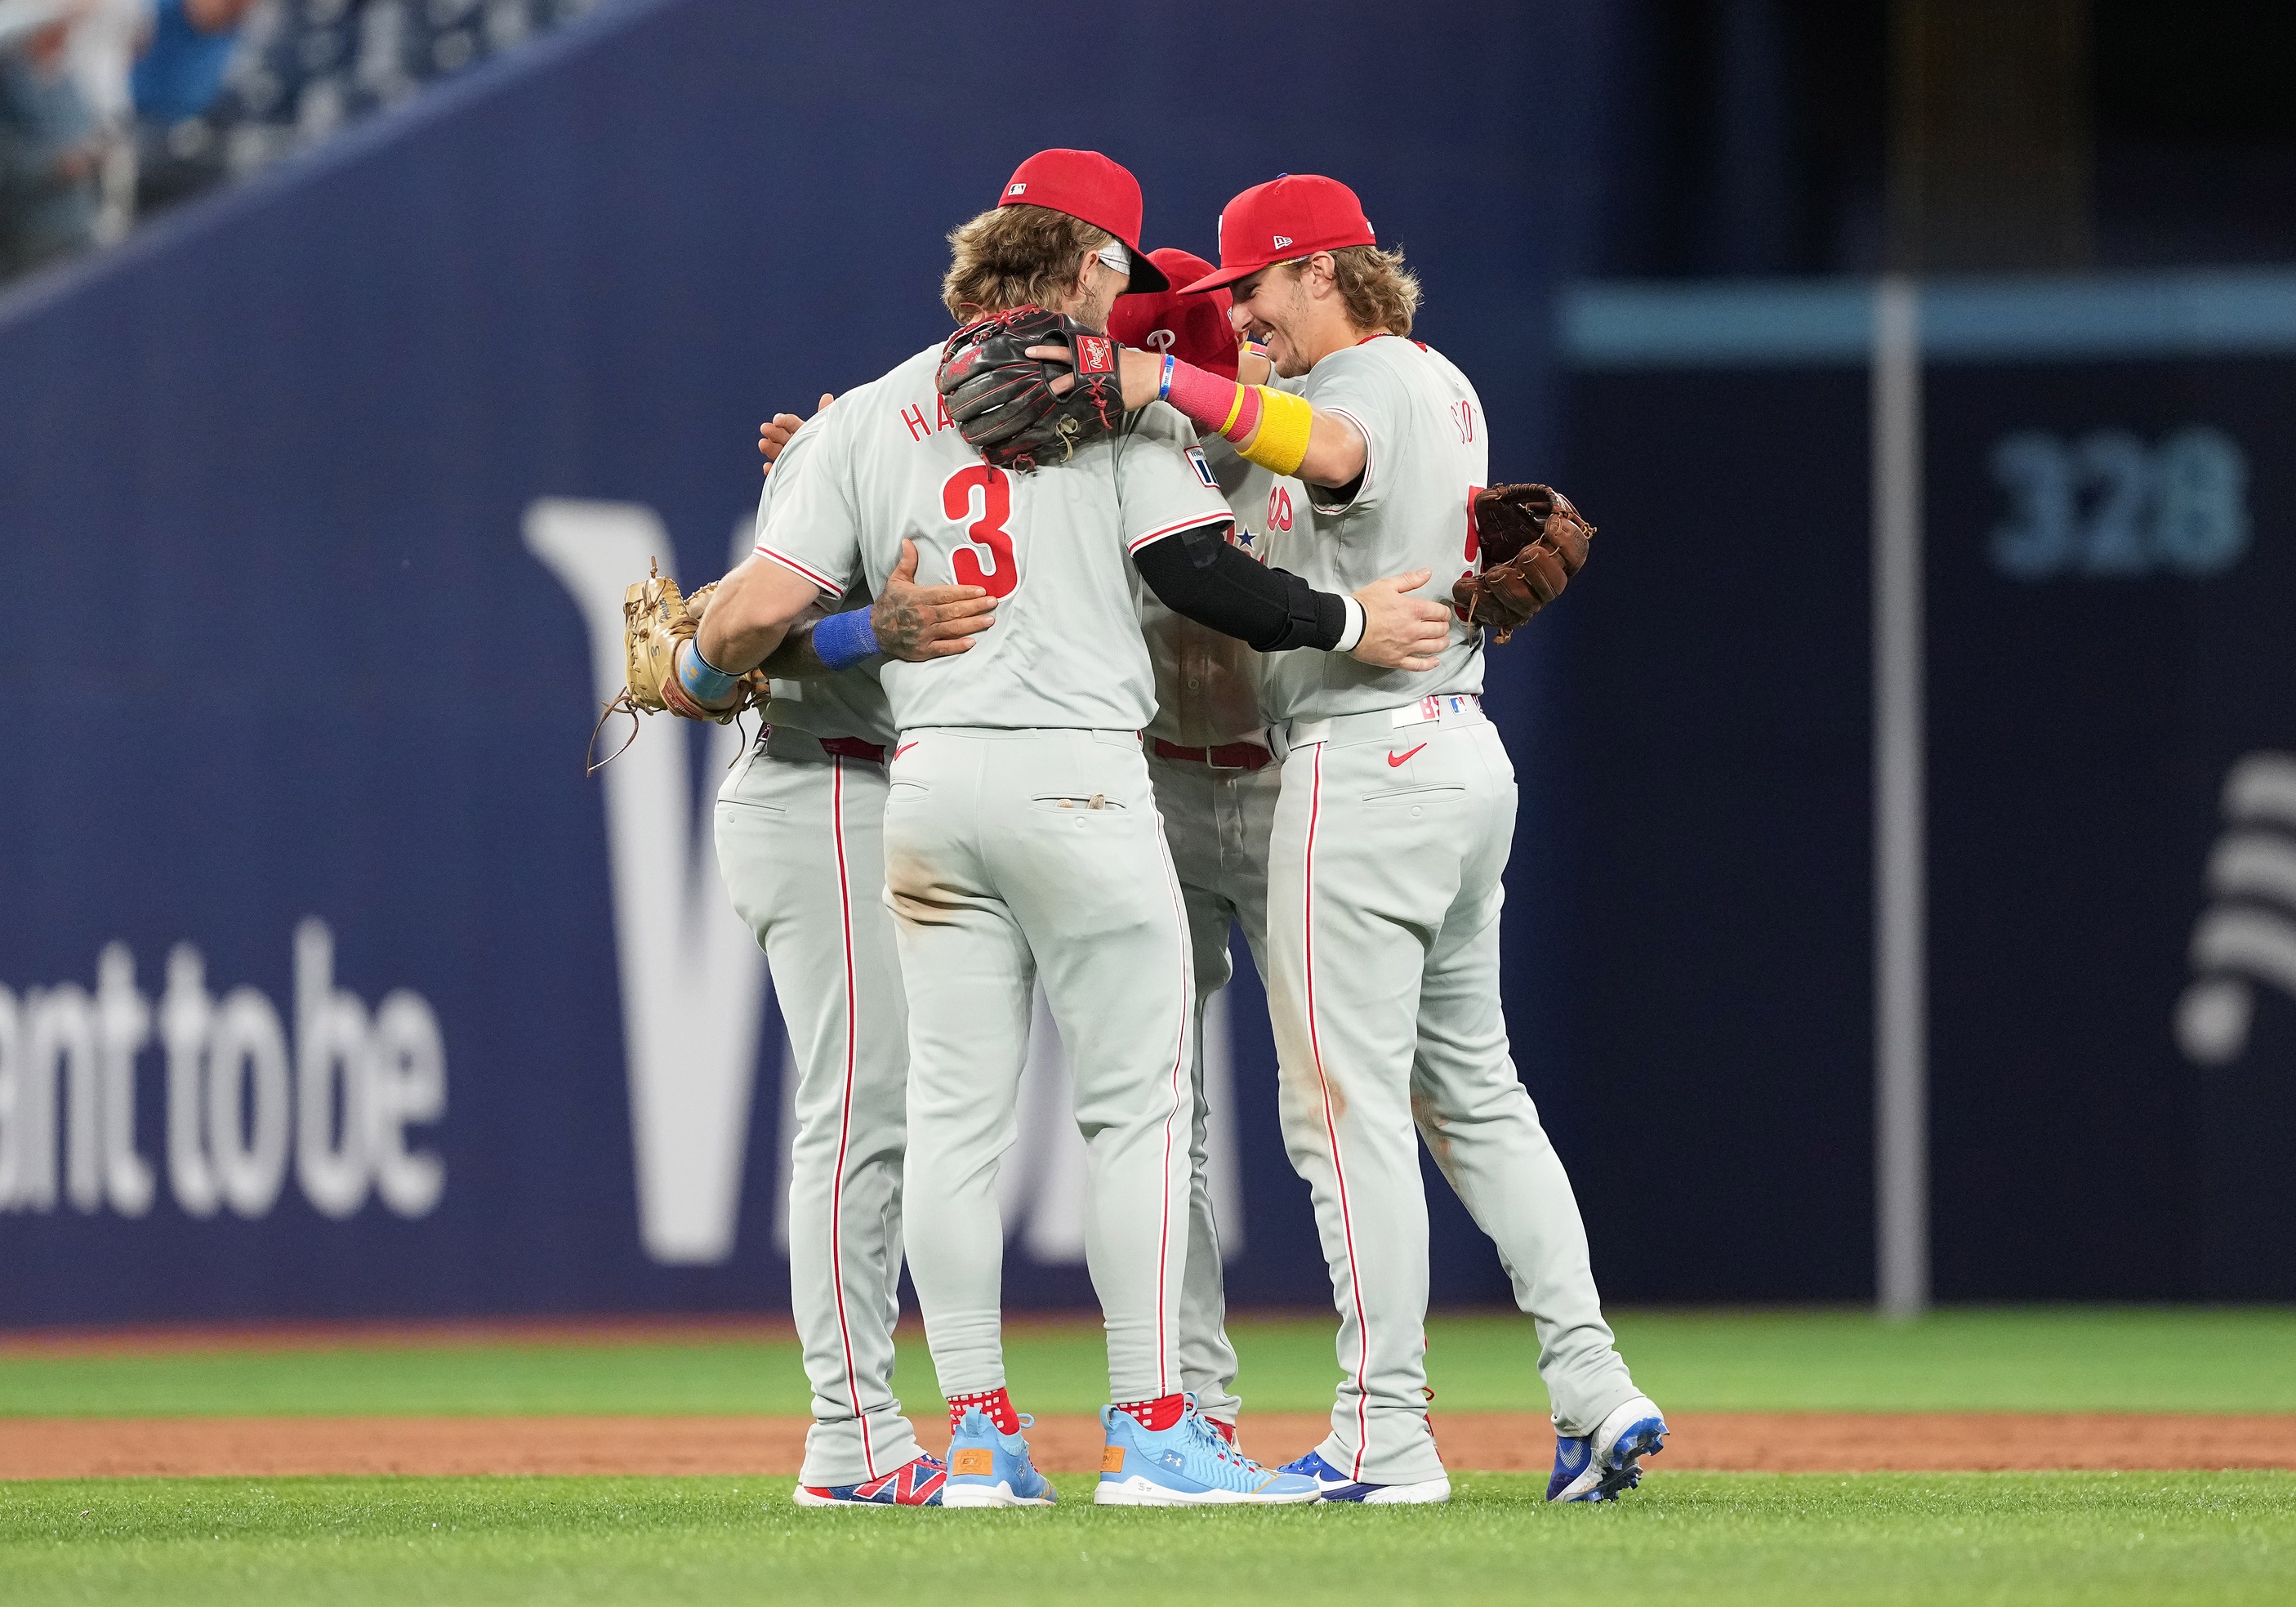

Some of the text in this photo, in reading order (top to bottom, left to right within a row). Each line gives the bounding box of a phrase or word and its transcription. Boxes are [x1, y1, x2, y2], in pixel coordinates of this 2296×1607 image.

[1147, 328, 1176, 355] P
[900, 392, 956, 443] HA
[939, 462, 1021, 602] 3
[1987, 426, 2254, 576] 328
[162, 940, 290, 1219] to
[293, 913, 448, 1219] be
